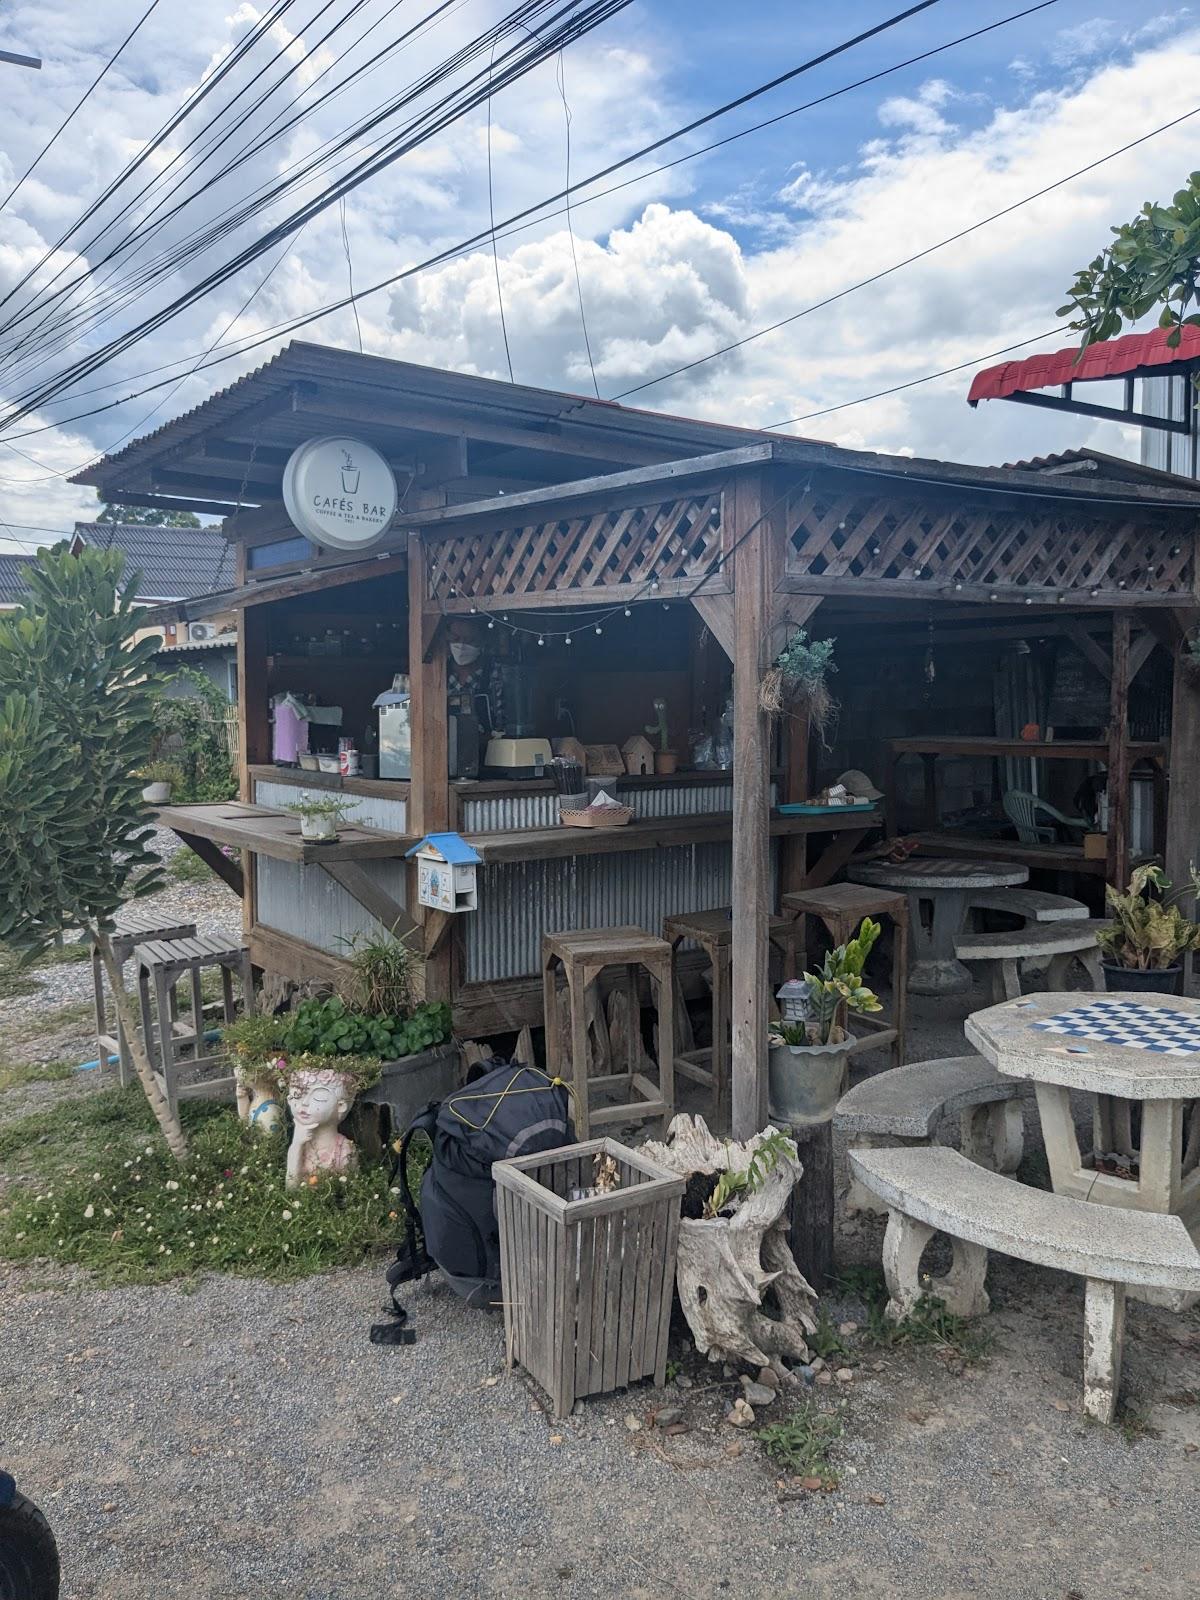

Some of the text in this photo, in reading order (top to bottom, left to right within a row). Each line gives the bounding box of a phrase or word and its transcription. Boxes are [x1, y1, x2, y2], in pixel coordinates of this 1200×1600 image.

[313, 495, 386, 517] CAFÉS BAR
[315, 508, 336, 517] COFFEE
